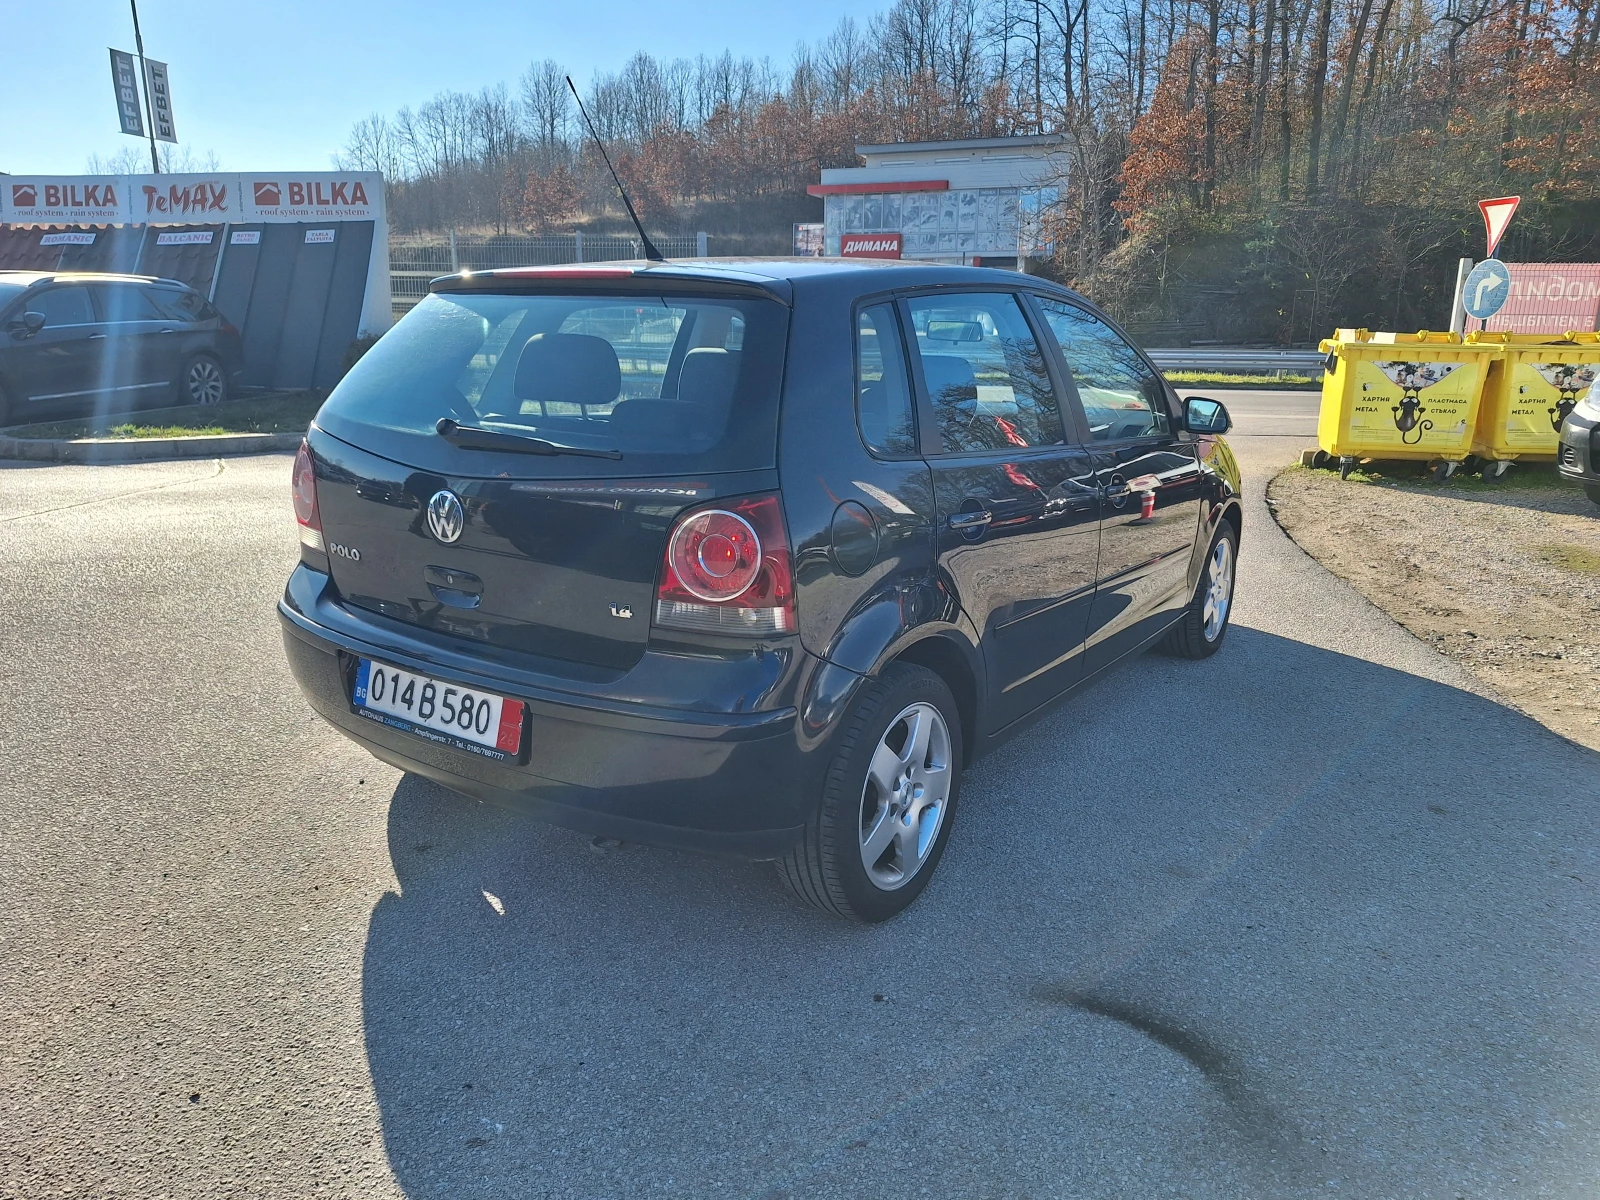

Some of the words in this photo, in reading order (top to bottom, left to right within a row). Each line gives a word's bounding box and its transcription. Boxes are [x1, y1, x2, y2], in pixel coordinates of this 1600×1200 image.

[116, 55, 138, 131] EFBET
[151, 64, 171, 137] EFBET
[45, 184, 118, 207] BILKA
[288, 182, 369, 206] BILKA
[35, 210, 63, 218] system
[88, 210, 114, 218] system
[260, 208, 278, 216] roof
[280, 209, 309, 217] system
[316, 207, 334, 215] rain
[336, 209, 365, 217] system
[43, 235, 92, 243] ROMANIC
[158, 233, 212, 243] BALCANIC
[843, 240, 898, 254] ДИМАНА
[330, 542, 360, 561] POLO
[356, 686, 367, 699] BG
[371, 668, 491, 735] 014B580
[358, 708, 384, 723] AUTOHAUS
[384, 717, 411, 731] ZANGBERG
